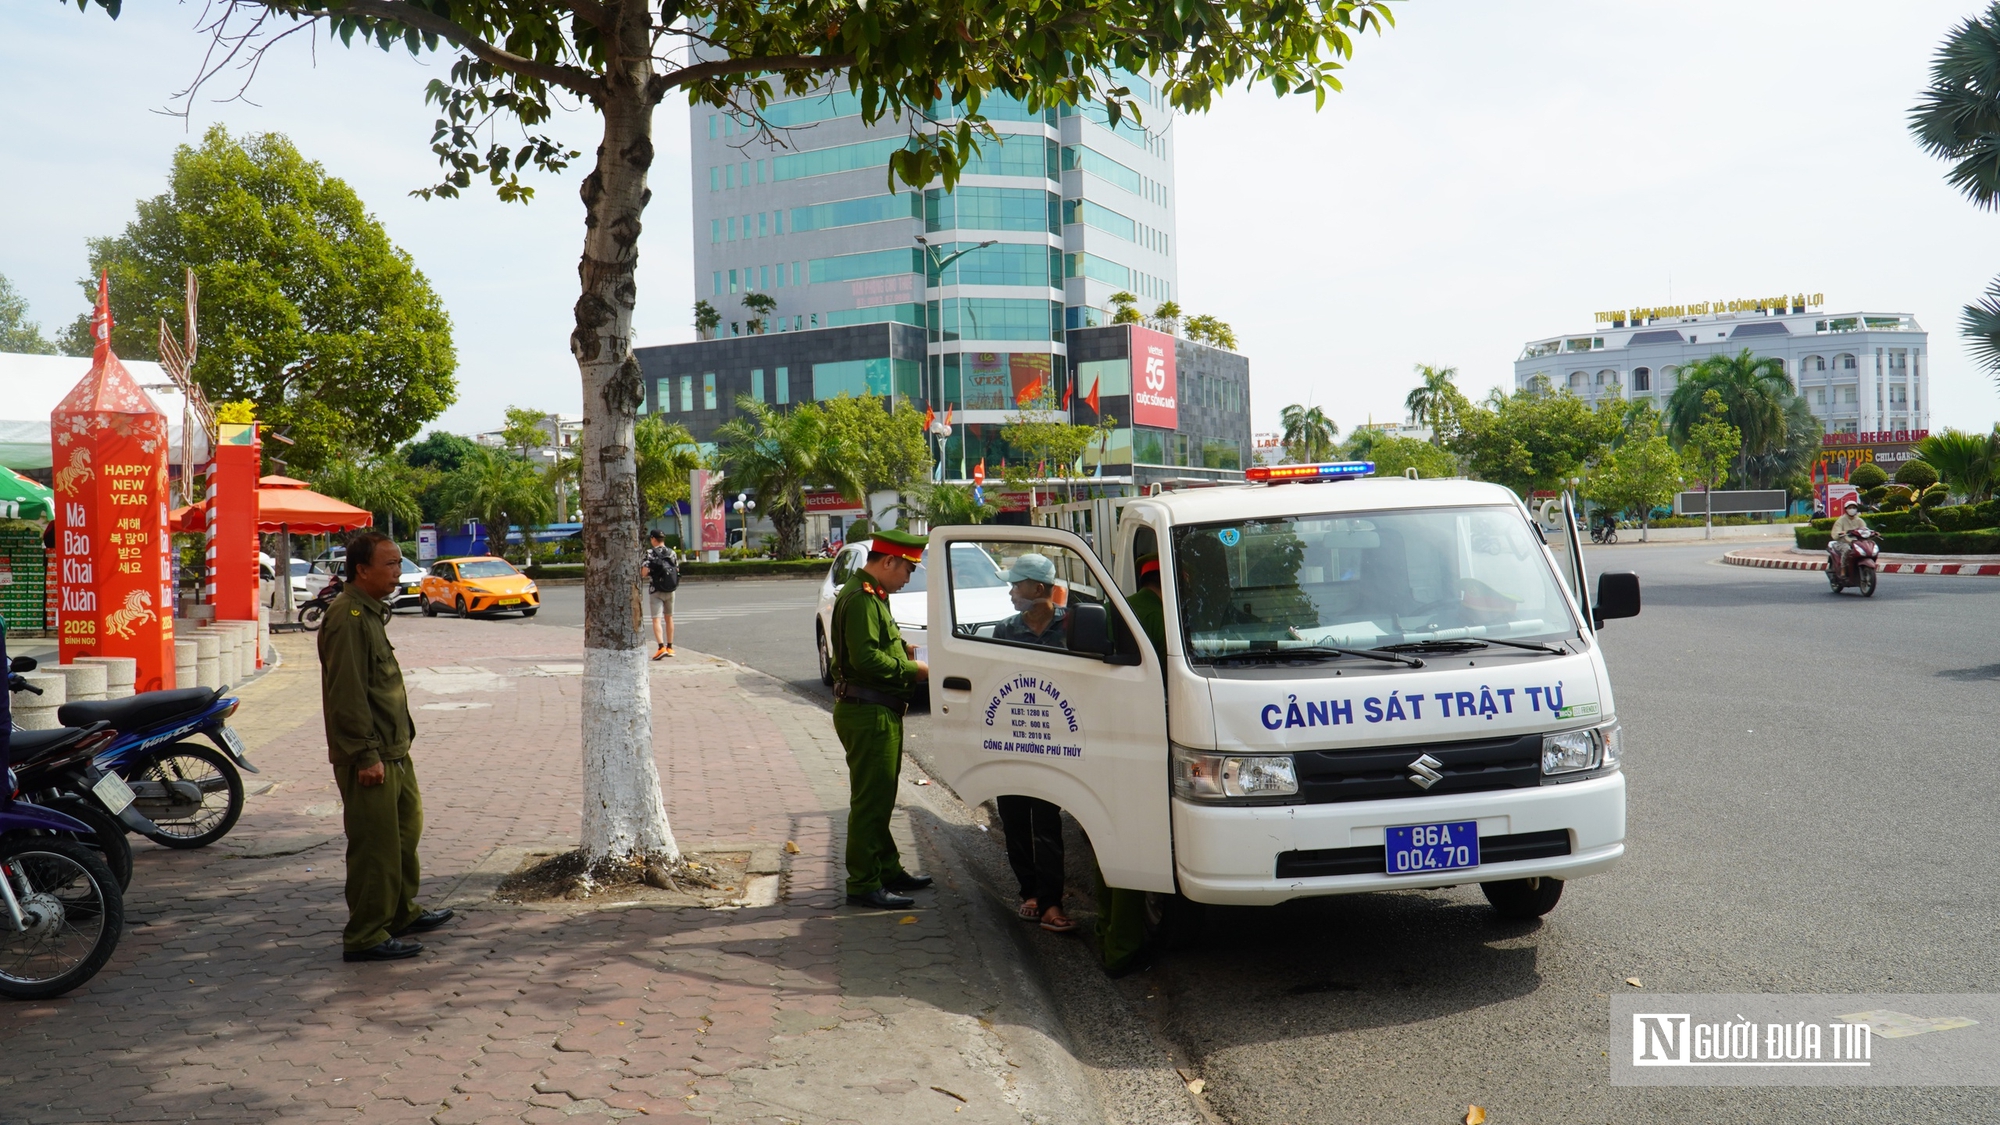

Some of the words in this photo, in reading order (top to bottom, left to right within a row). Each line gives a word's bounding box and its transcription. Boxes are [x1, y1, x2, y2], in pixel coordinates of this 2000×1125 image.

[1594, 310, 1626, 323] TRUNG
[1629, 306, 1651, 320] TÂM
[1653, 305, 1685, 319] NGOẠI
[1687, 301, 1709, 315] NGỮ
[1713, 299, 1725, 314] VÀ
[1728, 298, 1757, 312] CÔNG
[1792, 293, 1804, 307] LÊ
[1807, 293, 1824, 307] LỢI
[1145, 357, 1165, 391] 5G
[1136, 391, 1150, 406] CUỘC
[1150, 392, 1165, 407] SỐNG
[1823, 432, 1858, 445] OPUS
[1860, 431, 1892, 443] BEER
[1820, 448, 1873, 464] CTOPUS
[1875, 452, 1896, 462] CHILL
[105, 465, 152, 476] HAPPY
[113, 480, 145, 491] NEW
[110, 494, 148, 505] YEAR
[805, 496, 836, 505] iettel
[66, 503, 86, 527] Mã
[117, 518, 141, 529] 새해
[64, 531, 90, 555] Đáo
[110, 533, 122, 545] 복
[125, 533, 148, 545] 많이
[118, 547, 142, 559] 받으
[63, 558, 92, 583] Khai
[118, 562, 142, 574] 세요
[62, 587, 96, 611] Xuân
[64, 620, 96, 634] 2026
[64, 635, 81, 645] BÍNH
[81, 637, 96, 647] NGỌ
[985, 696, 1001, 726] CÔNG
[999, 683, 1013, 698] AN
[1013, 673, 1037, 689] TỈNH
[1039, 680, 1060, 701] LÂM
[1059, 699, 1079, 733] ĐỒNG
[1023, 692, 1036, 705] 2N
[1261, 694, 1353, 731] CẢNH
[1364, 690, 1425, 723] SÁT
[1434, 685, 1516, 721] TRẬT
[1524, 680, 1564, 718] TỰ
[1011, 708, 1025, 716] KLBT:
[1026, 709, 1041, 717] 1280
[1581, 705, 1597, 714] FRIENDLY
[1011, 719, 1027, 727] KLCP:
[1042, 721, 1050, 729] KG
[1013, 730, 1027, 739] KLTB:
[1028, 732, 1042, 740] 2010
[983, 738, 1002, 751] CÔNG
[1004, 742, 1014, 752] AN
[1015, 741, 1045, 754] PHƯỜNG
[1046, 743, 1061, 756] PHÚ
[1063, 743, 1082, 758] THỦY
[1412, 825, 1452, 847] 86A
[1396, 846, 1469, 870] 004.70
